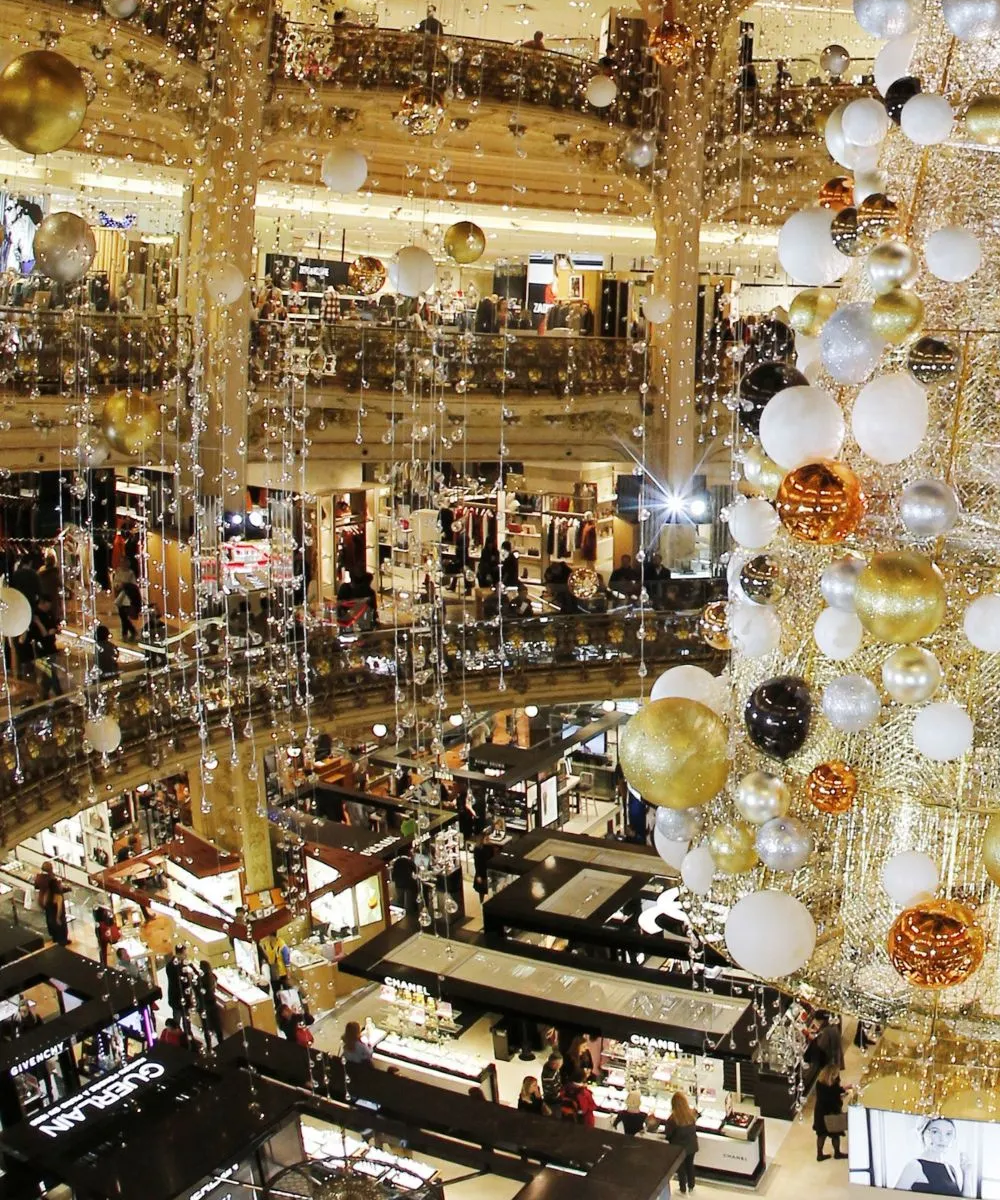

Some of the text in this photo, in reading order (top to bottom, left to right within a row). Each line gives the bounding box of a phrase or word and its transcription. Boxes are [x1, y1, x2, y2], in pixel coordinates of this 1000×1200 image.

[384, 976, 430, 996] CHANEL
[630, 1034, 683, 1053] CHANEL
[9, 1041, 66, 1076] GIVENCHY
[38, 1062, 165, 1137] GUERLAIN
